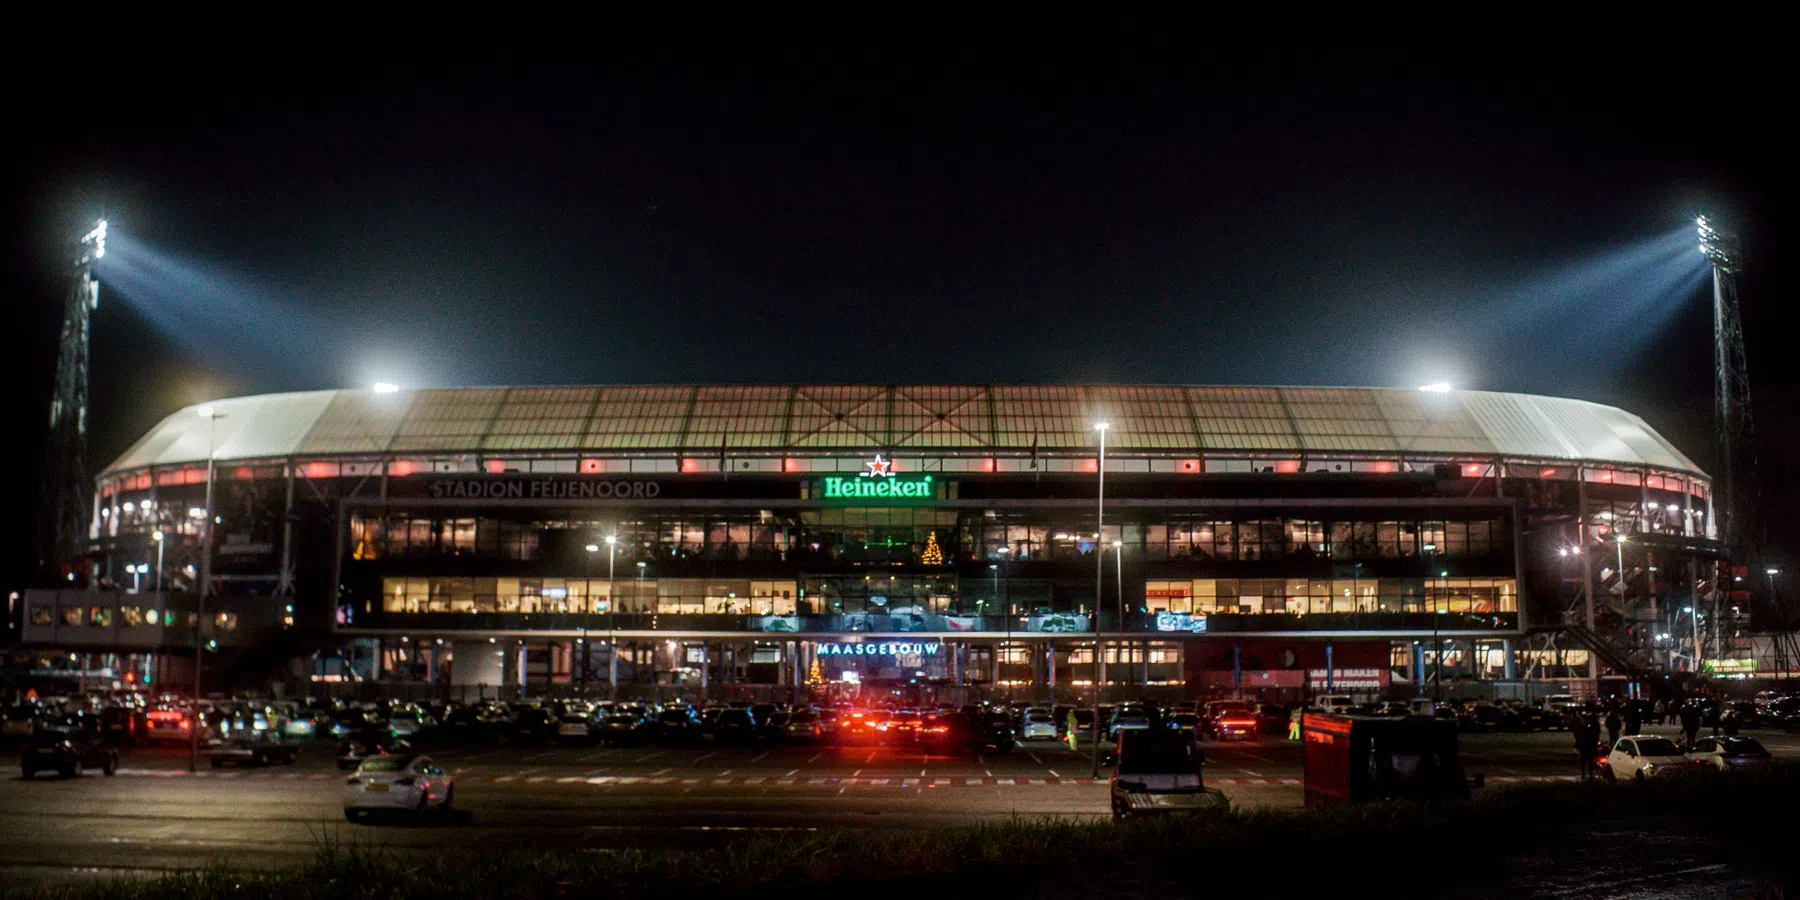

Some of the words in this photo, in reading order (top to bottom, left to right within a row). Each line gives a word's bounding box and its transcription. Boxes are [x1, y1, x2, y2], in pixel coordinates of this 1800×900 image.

[432, 480, 523, 498] STADION
[530, 480, 660, 498] FEIJENOORD
[825, 476, 932, 498] Heineken
[817, 643, 938, 655] MAASGEBOUW
